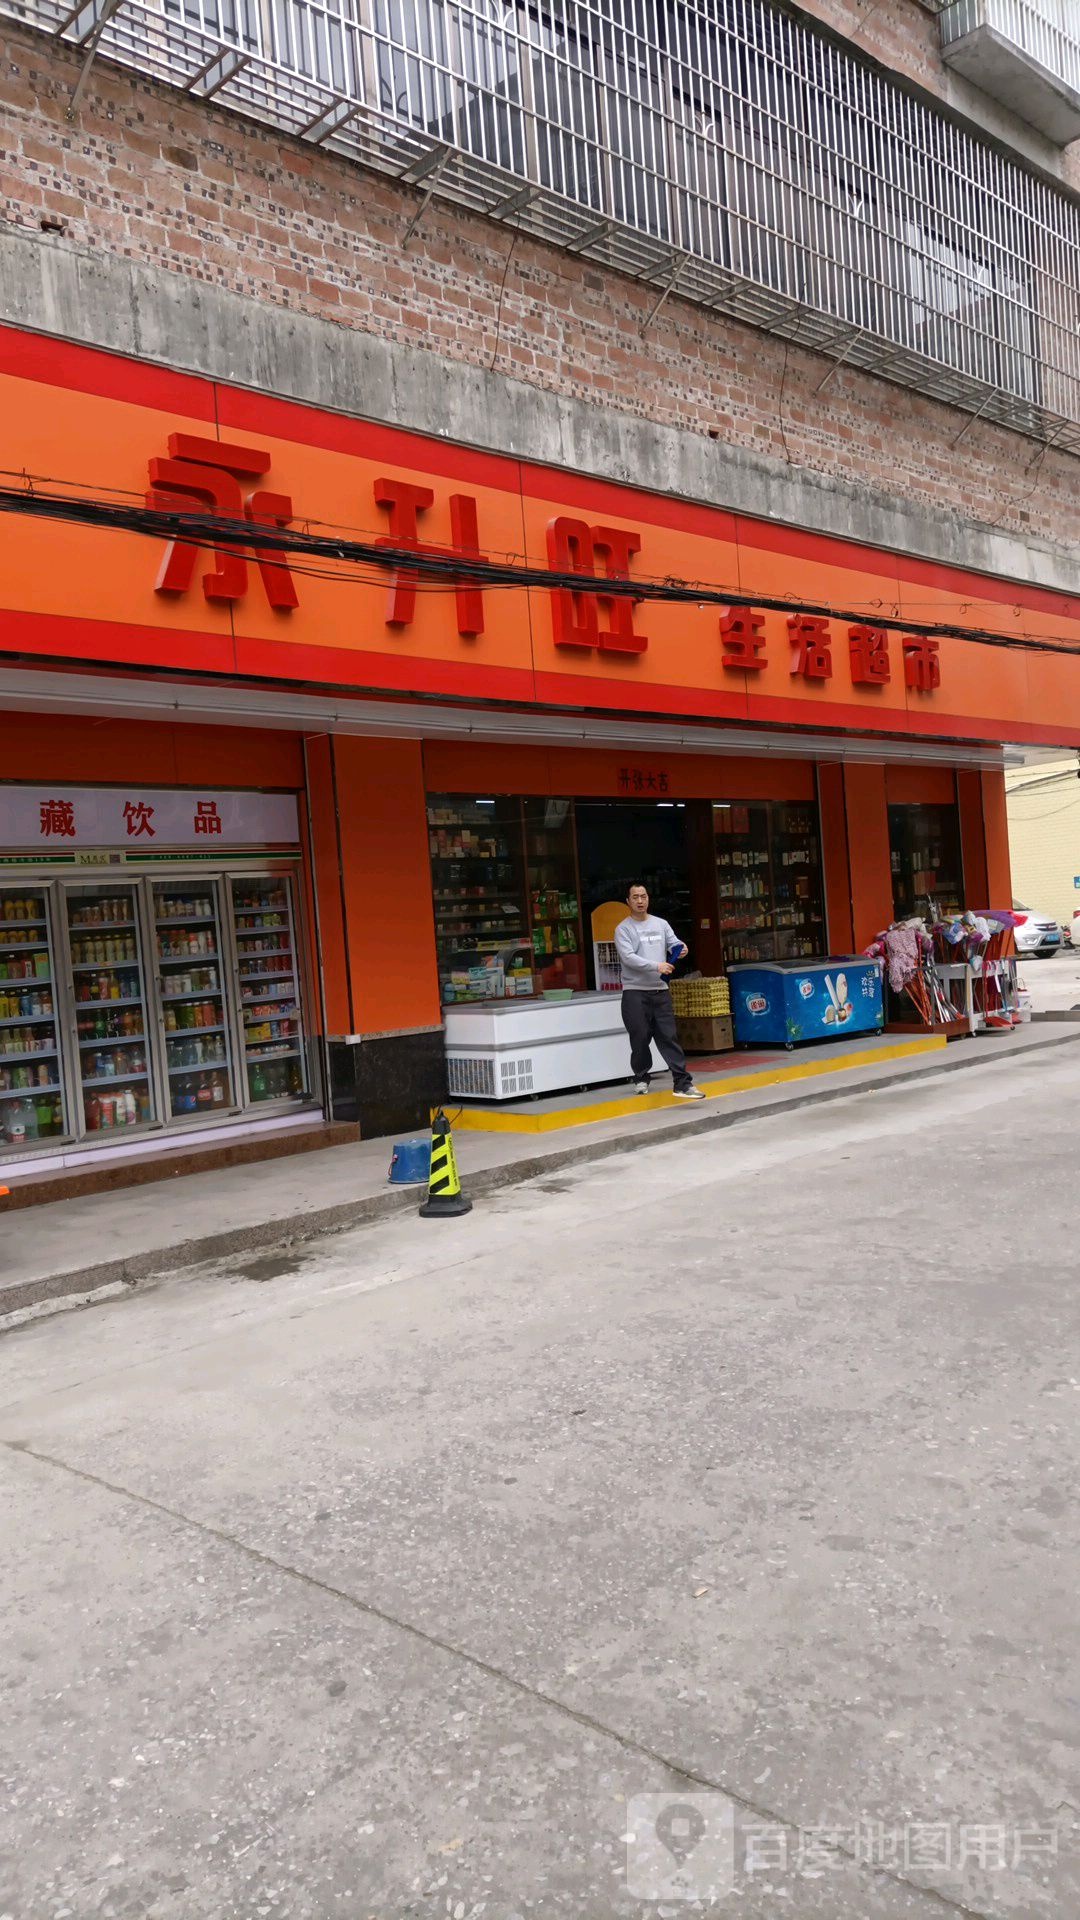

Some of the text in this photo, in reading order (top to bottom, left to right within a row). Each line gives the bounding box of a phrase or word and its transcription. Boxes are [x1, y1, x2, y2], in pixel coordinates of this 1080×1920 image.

[719, 606, 941, 692] 生活超市
[619, 768, 669, 792] 开张大吉
[39, 799, 222, 837] 藏饮品
